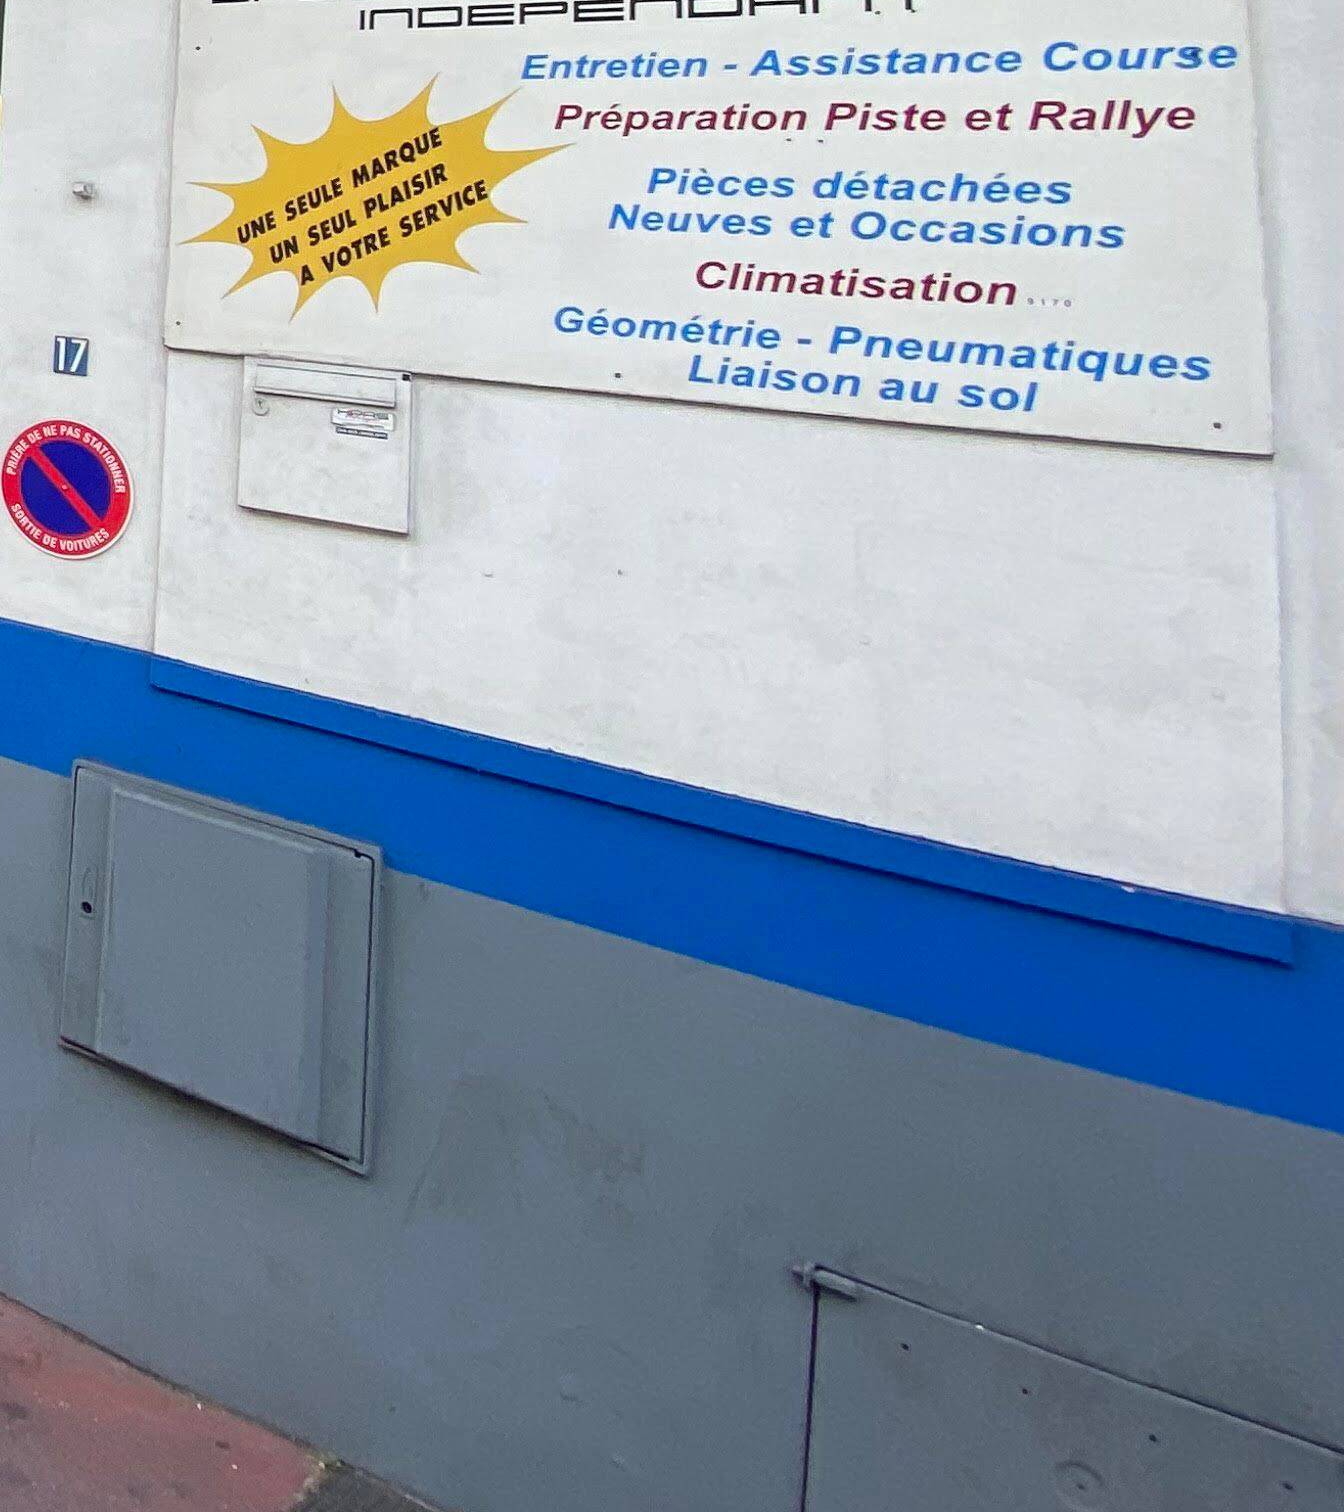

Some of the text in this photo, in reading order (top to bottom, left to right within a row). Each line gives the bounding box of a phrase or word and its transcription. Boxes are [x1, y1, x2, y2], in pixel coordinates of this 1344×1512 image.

[521, 51, 708, 80] Entretien
[751, 47, 1022, 77] Assistance
[1042, 39, 1238, 72] Course
[554, 99, 1197, 139] Préparation Piste et Rallye
[237, 127, 443, 245] UNE SEULE MARQUE
[647, 166, 1072, 205] Pièces détachées
[269, 163, 449, 264] UN SEUL PLAISIR
[299, 179, 489, 286] A VOTRE SERVICE
[608, 203, 1126, 250] Neuves et Occasions
[695, 261, 1017, 306] Climatisation
[55, 337, 87, 373] 17
[554, 306, 782, 350] Géométrie
[829, 325, 1211, 385] Pneumatiques
[687, 353, 1039, 413] Liaison au sol
[27, 430, 43, 445] DE
[43, 424, 58, 437] NE
[60, 424, 81, 439] PAS
[83, 432, 126, 494] STATIONNER
[10, 502, 110, 552] SORTIE DE VOITURES
